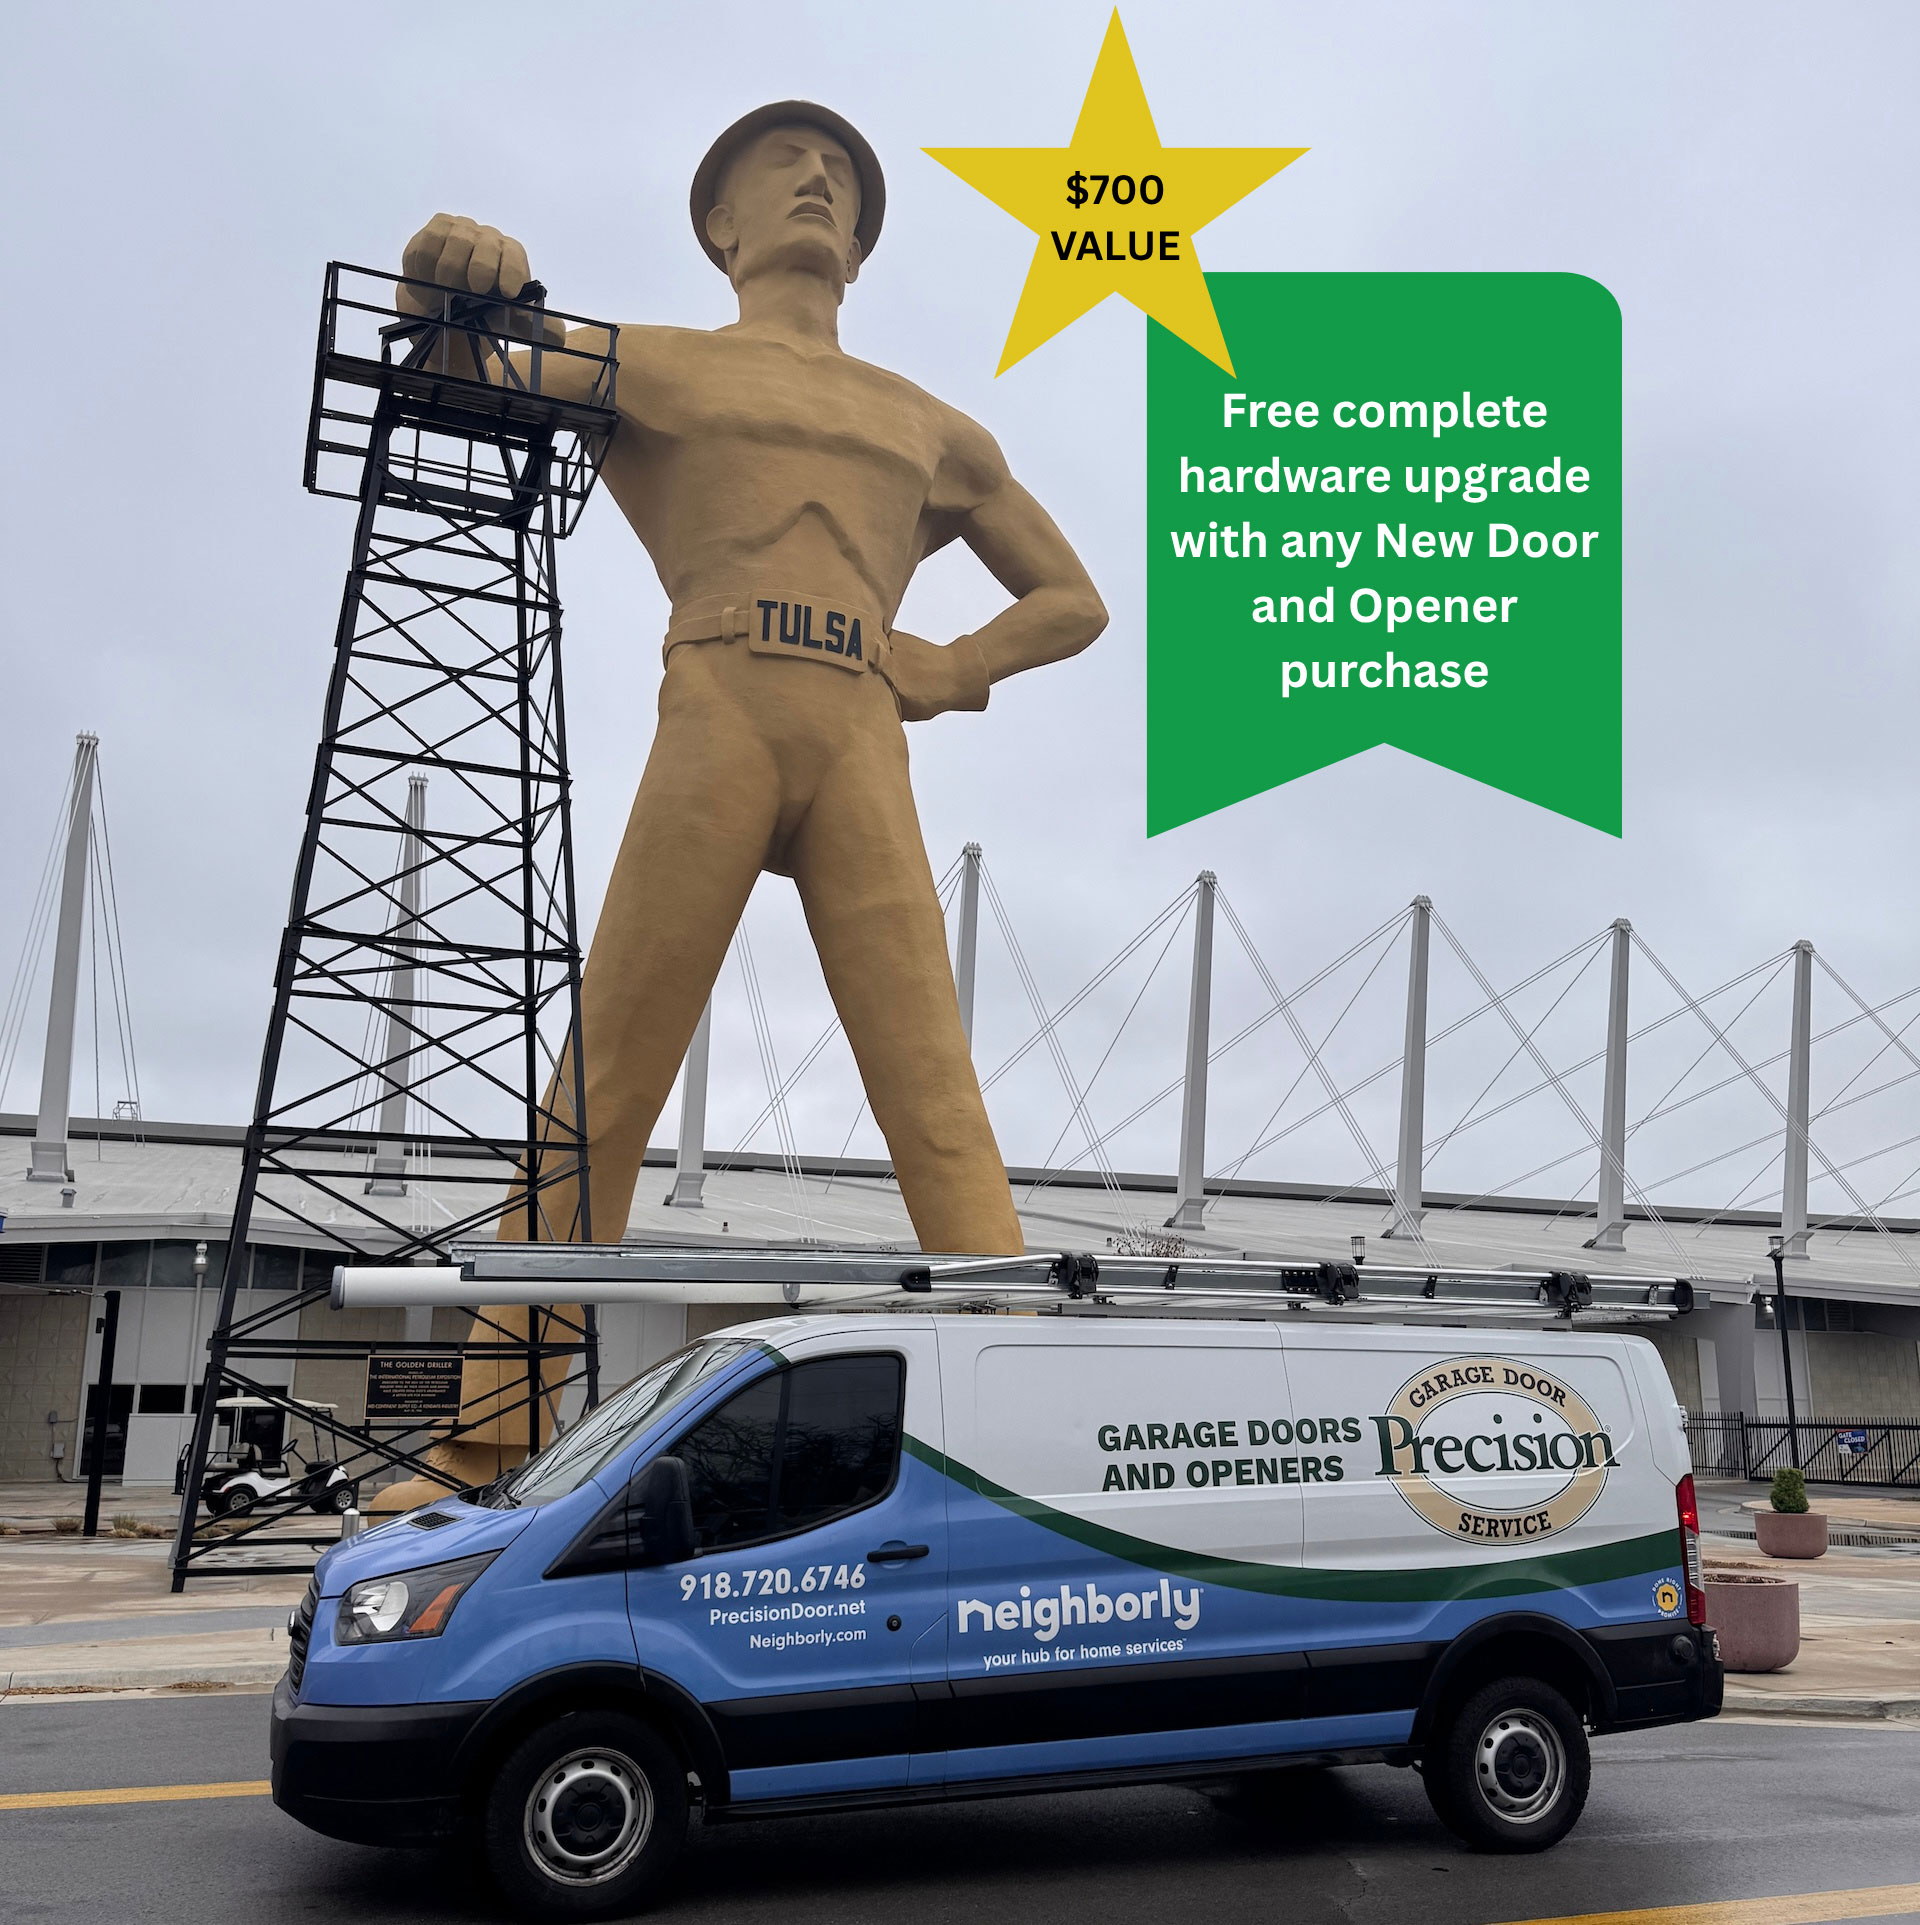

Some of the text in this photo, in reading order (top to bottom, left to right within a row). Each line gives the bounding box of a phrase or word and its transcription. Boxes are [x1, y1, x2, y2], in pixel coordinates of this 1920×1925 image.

[757, 599, 862, 661] TULSA
[1409, 1366, 1567, 1409] GARAGE DOOR
[1097, 1417, 1362, 1452] GARAGE DOORS
[1368, 1413, 1622, 1477] Precision
[1102, 1455, 1345, 1492] AND OPENERS
[1458, 1510, 1552, 1538] SERVICE
[679, 1563, 866, 1601] 918.720.6746
[710, 1599, 866, 1626] PrecisionDoor.net
[957, 1578, 1200, 1642] neighborly
[749, 1628, 867, 1650] Neighborly.com
[983, 1637, 1184, 1671] your hub for home services
